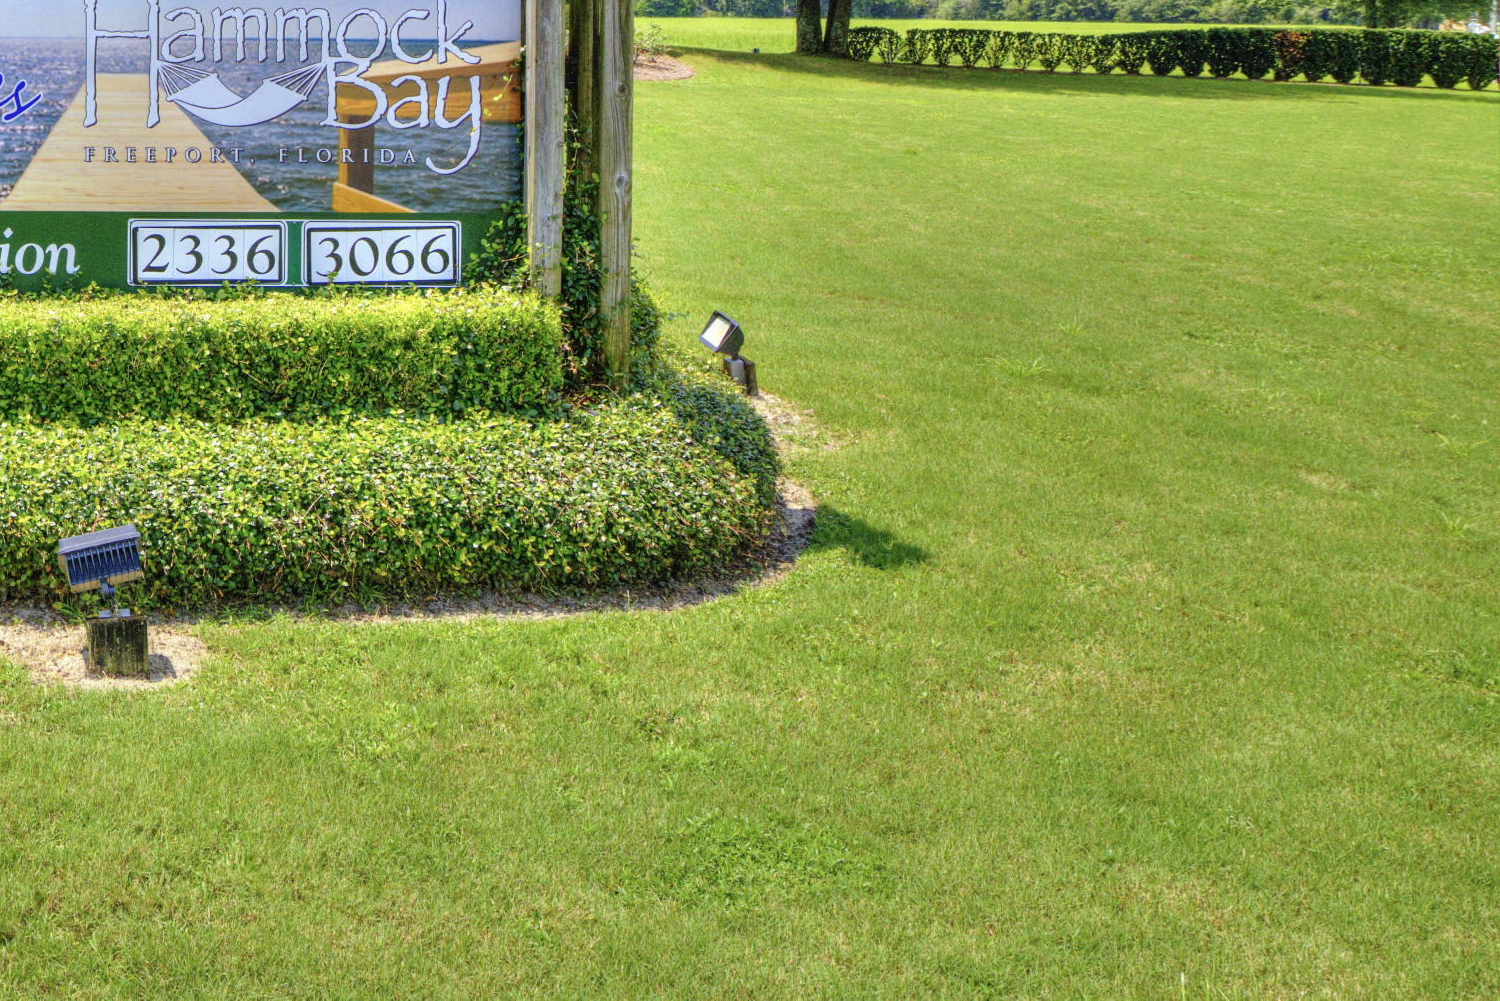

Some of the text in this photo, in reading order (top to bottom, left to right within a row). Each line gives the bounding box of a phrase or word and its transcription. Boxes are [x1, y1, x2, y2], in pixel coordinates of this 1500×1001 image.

[319, 55, 483, 176] Bay
[83, 146, 418, 165] FREEPORT, FLORIDA
[141, 233, 276, 275] 2336
[315, 233, 451, 279] 3066
